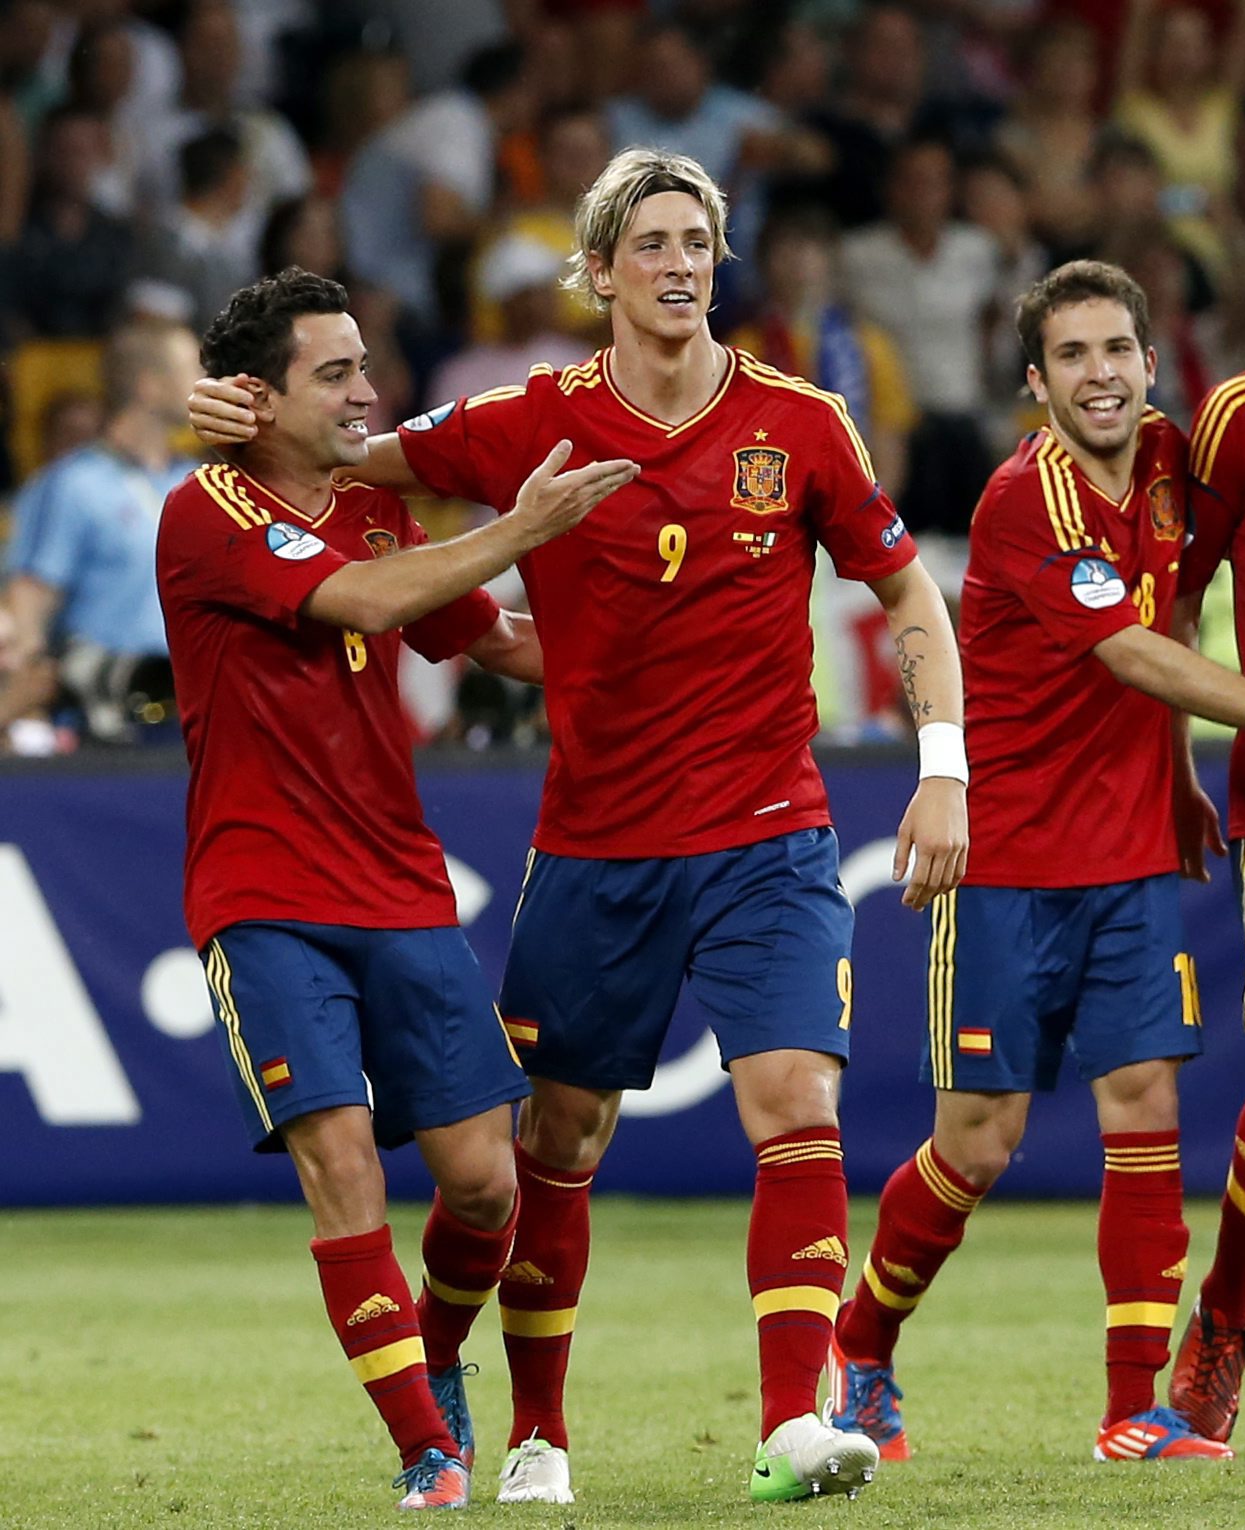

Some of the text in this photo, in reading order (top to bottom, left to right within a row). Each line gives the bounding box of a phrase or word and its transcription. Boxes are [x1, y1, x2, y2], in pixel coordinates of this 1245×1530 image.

[658, 524, 687, 582] 9
[837, 957, 852, 1031] 9
[791, 1248, 848, 1268] adidas
[346, 1303, 400, 1326] adidas
